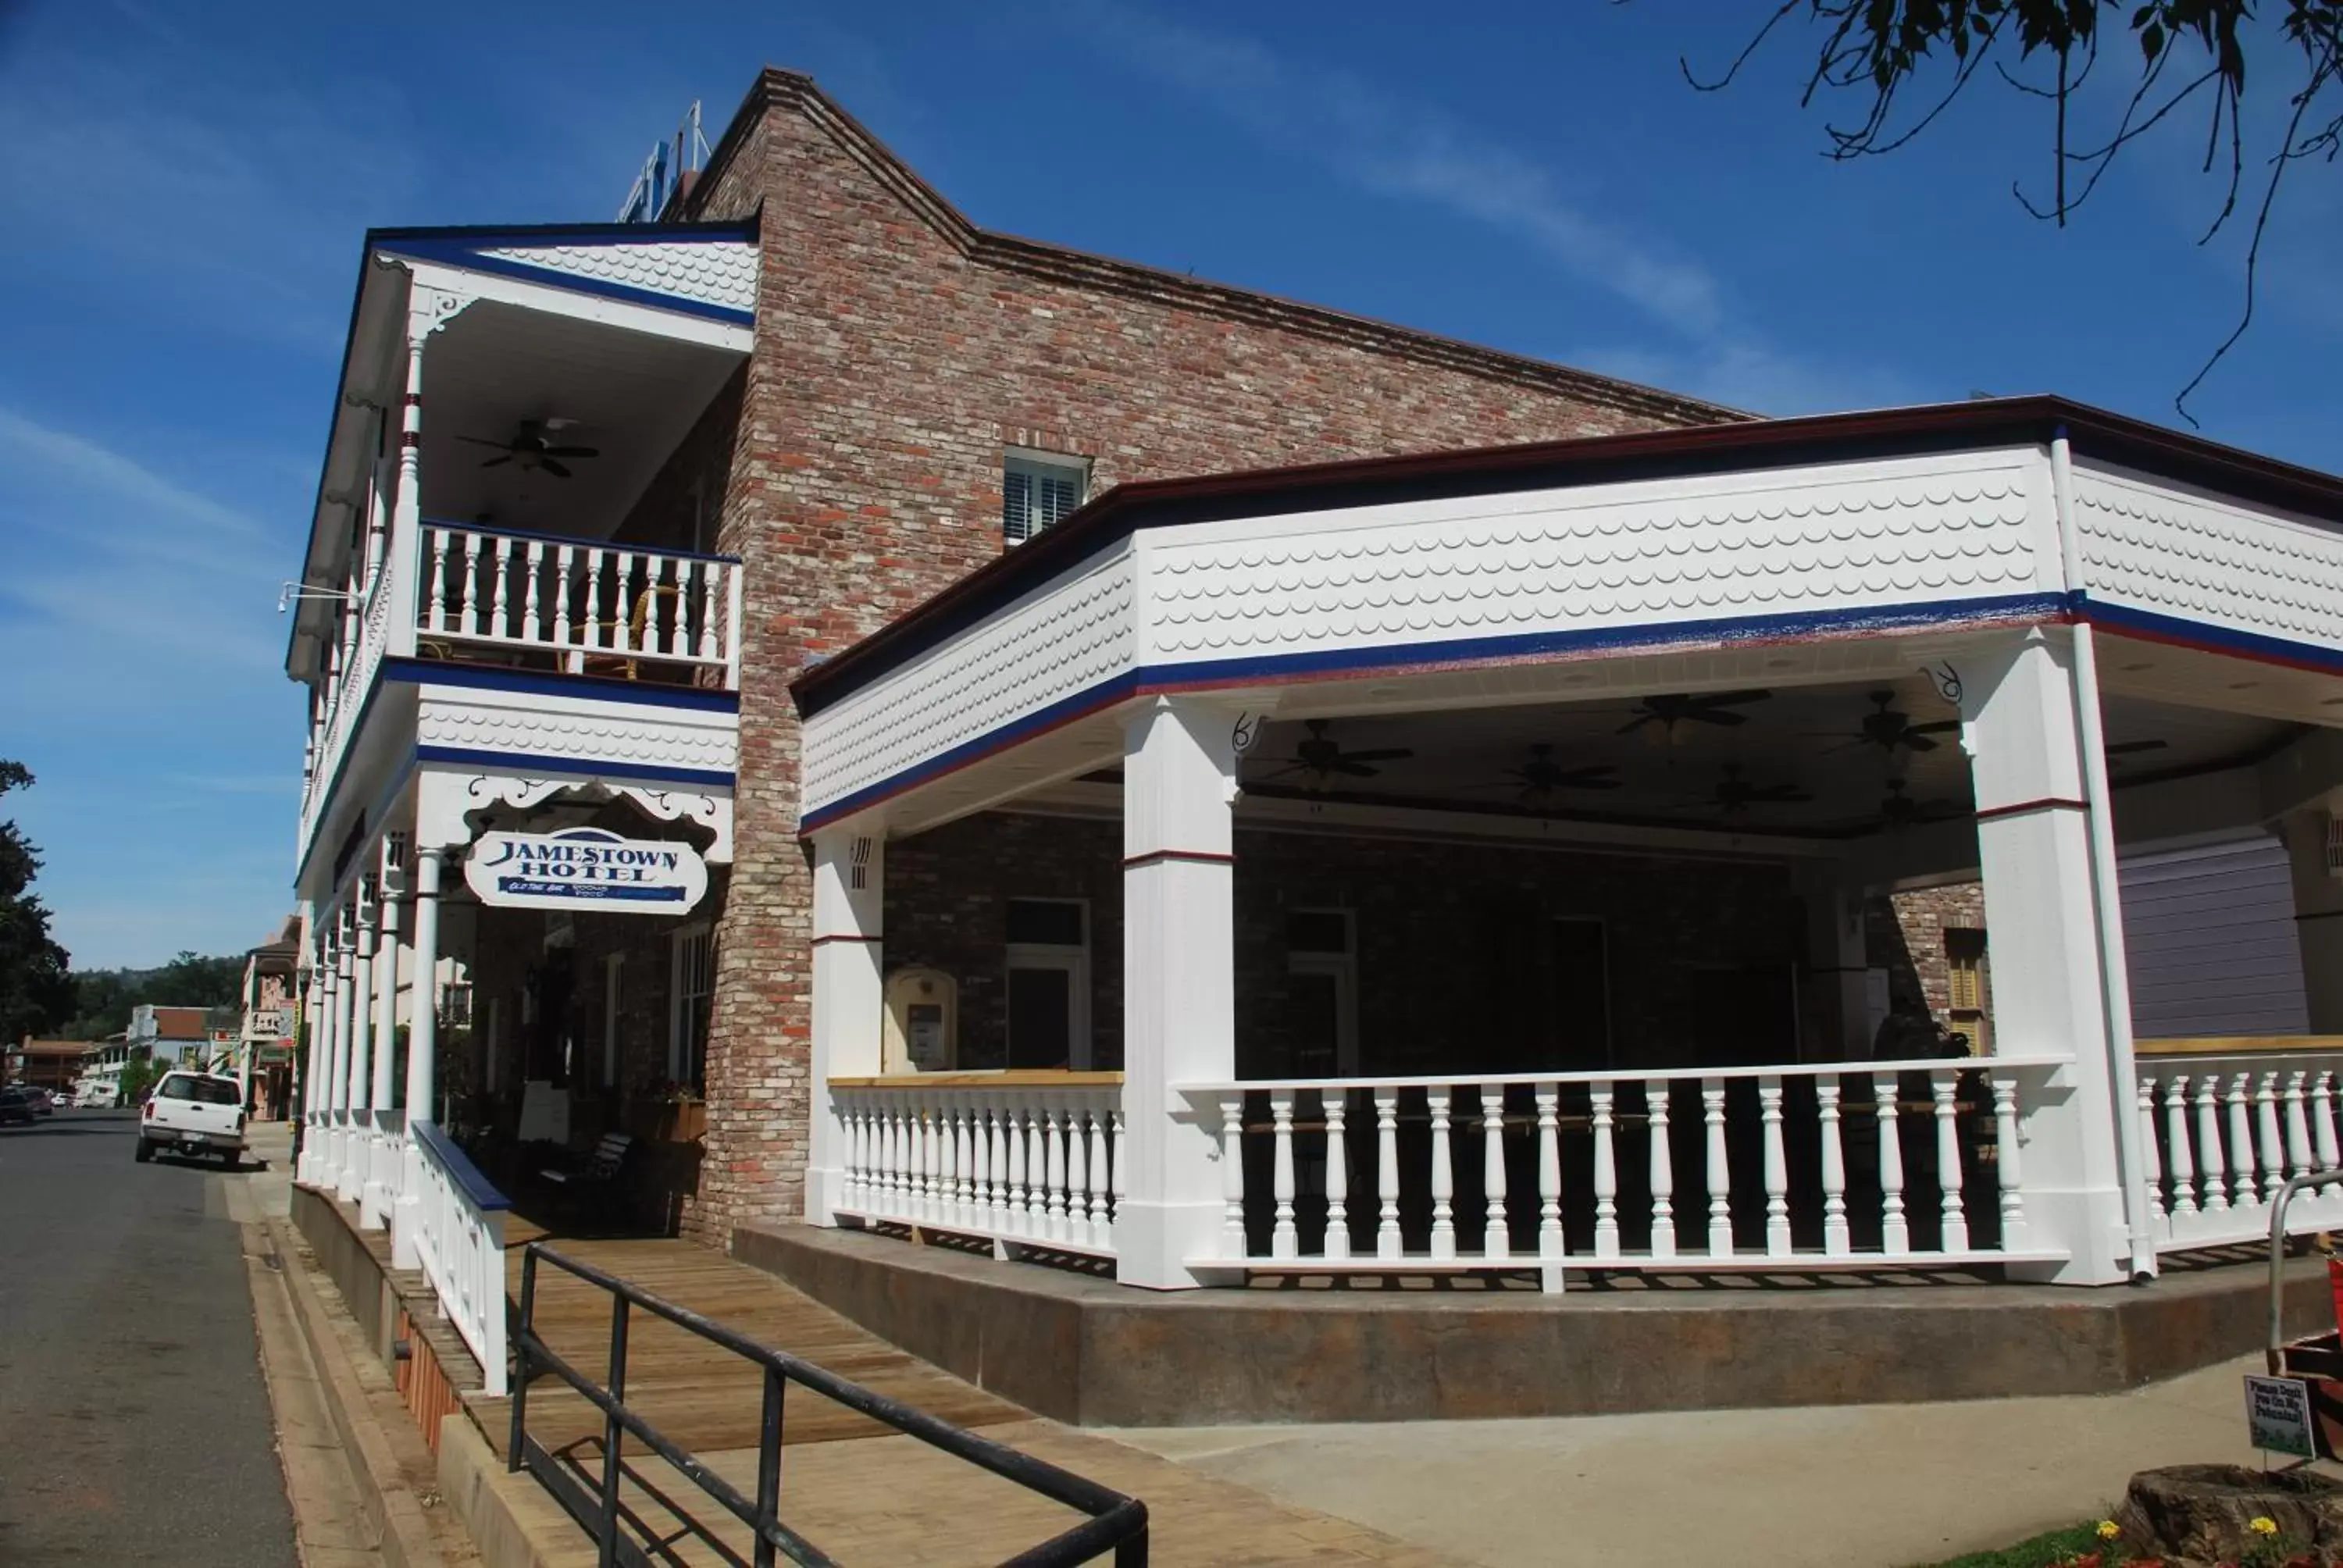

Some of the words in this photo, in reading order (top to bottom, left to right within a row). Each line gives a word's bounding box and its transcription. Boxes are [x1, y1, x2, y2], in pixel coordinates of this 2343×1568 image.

[484, 842, 678, 871] JAMESTOWN
[519, 861, 659, 882] HOTEL
[2249, 1381, 2278, 1394] Please
